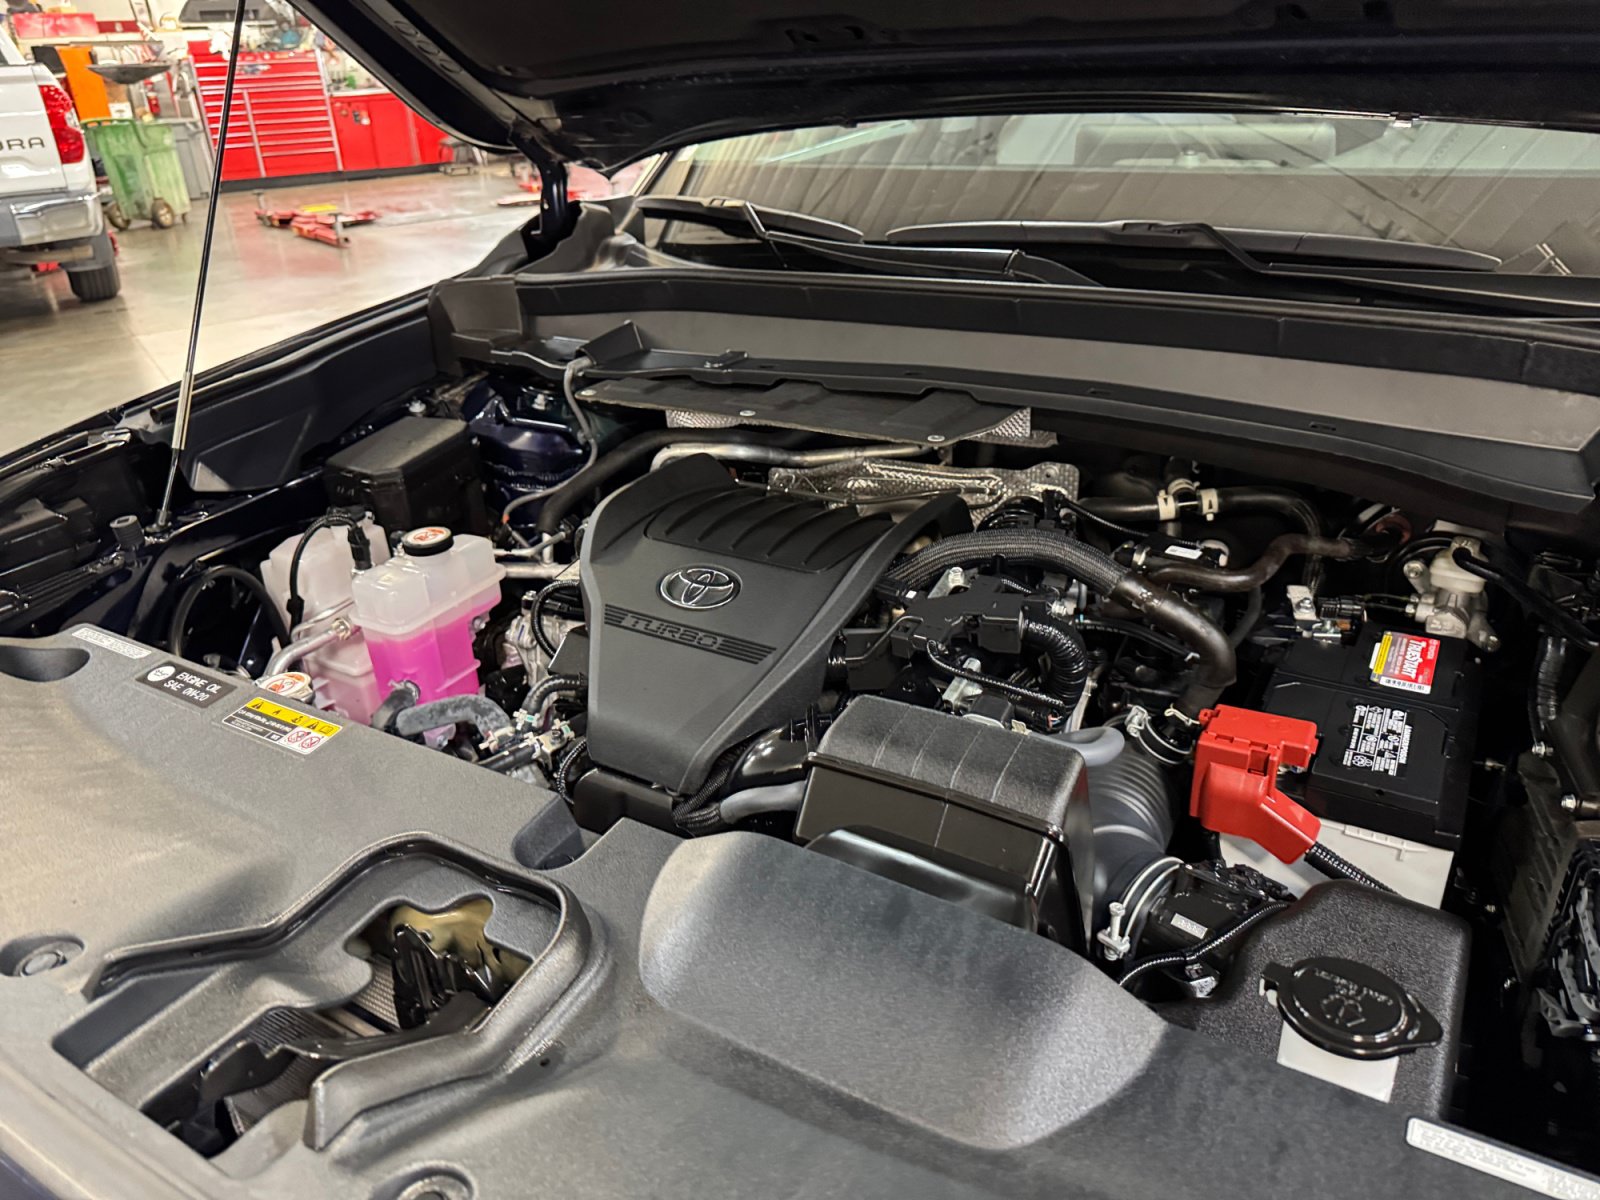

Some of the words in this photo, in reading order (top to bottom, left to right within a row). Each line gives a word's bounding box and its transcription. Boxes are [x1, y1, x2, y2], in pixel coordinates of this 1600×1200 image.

[0, 137, 45, 151] RA
[630, 615, 718, 647] TURBO
[163, 680, 185, 691] SAE
[176, 672, 208, 688] ENGINE
[205, 683, 222, 694] OIL
